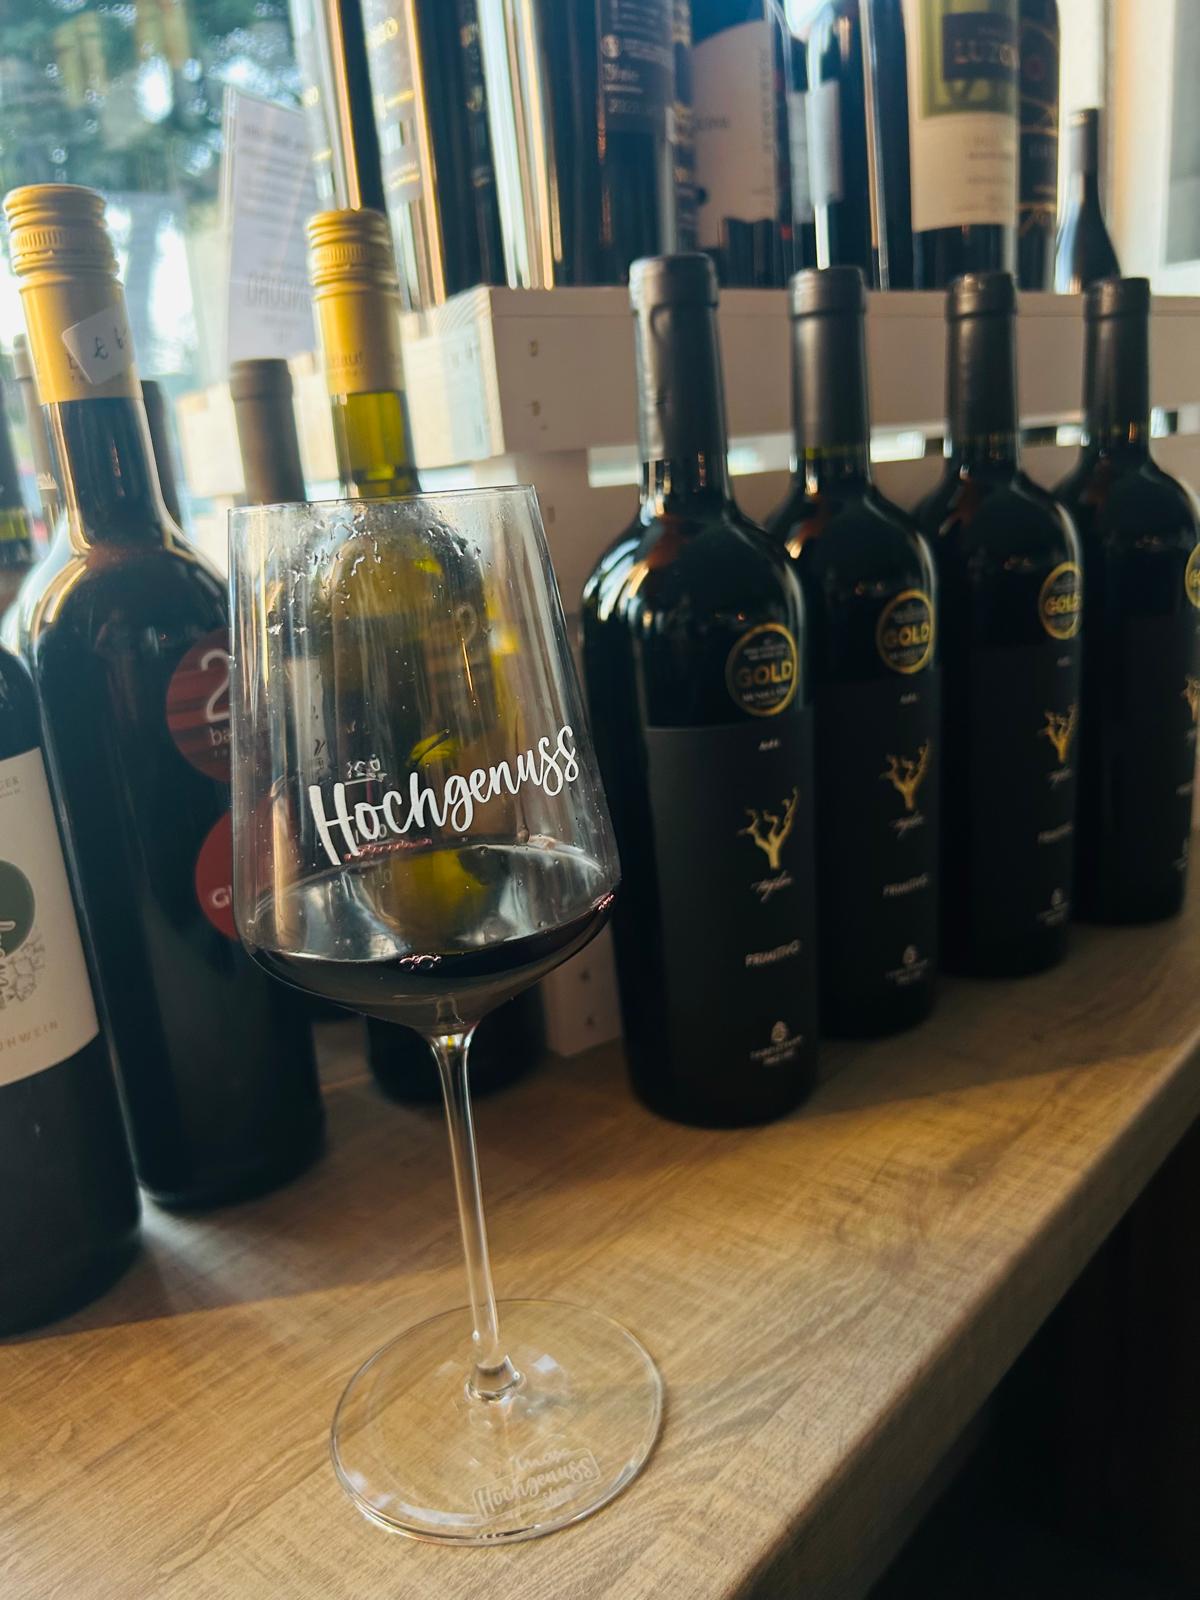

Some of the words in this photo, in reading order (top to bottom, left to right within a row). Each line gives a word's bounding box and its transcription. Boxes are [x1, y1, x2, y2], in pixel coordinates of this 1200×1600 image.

[883, 622, 930, 648] GOLD
[736, 660, 793, 689] GOLD
[308, 725, 580, 866] Hochgenuss
[476, 1457, 594, 1519] Hochgenuss
